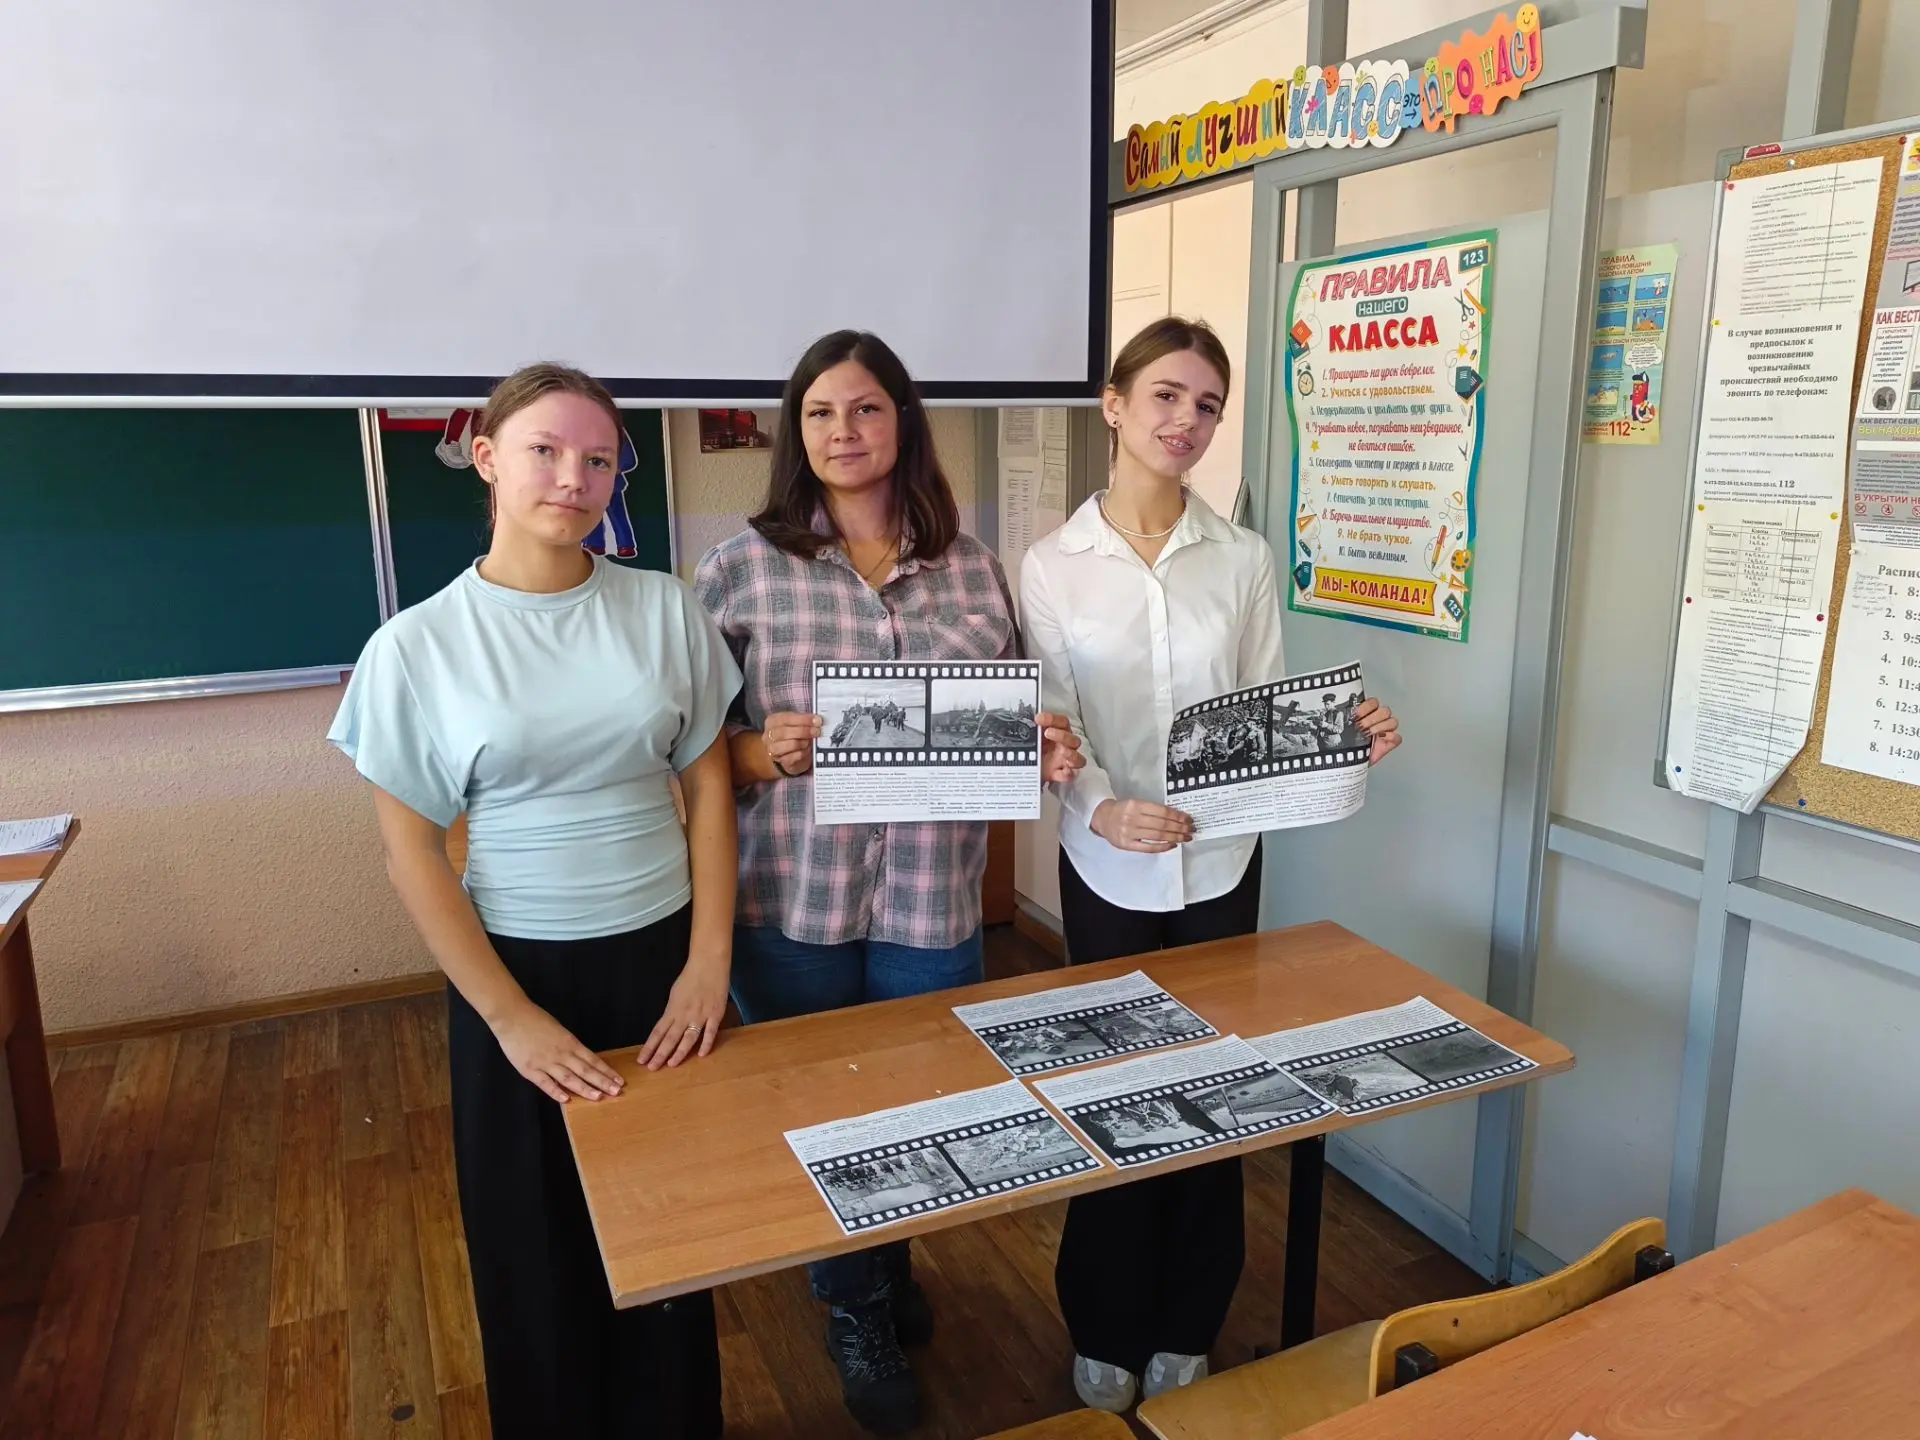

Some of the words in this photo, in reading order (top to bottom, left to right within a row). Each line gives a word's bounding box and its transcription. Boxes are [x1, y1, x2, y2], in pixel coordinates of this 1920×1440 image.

[1127, 120, 1181, 186] Самый
[1187, 84, 1286, 167] лучший
[1288, 73, 1403, 139] КЛАСС
[1424, 58, 1475, 120] ПРО
[1479, 30, 1537, 89] НАС!
[1462, 250, 1484, 266] 123
[1319, 257, 1452, 302] ПРАВИЛА
[1358, 298, 1407, 315] нашего
[1876, 312, 1894, 325] КАК
[1328, 315, 1440, 353] КЛАССА
[1735, 329, 1763, 338] случае
[1764, 324, 1833, 336] возникновения
[1749, 338, 1806, 349] предпосылок
[1747, 350, 1814, 360] возникновению
[1748, 362, 1811, 374] чрезвычайных
[1720, 376, 1782, 387] происшествий
[1783, 374, 1838, 384] необходимо
[1321, 388, 1329, 397] 2.
[1330, 387, 1361, 398] Учиться
[1775, 388, 1828, 397] телефонам:
[1609, 421, 1631, 436] 112
[1321, 476, 1329, 485] 6.
[1330, 475, 1353, 487] Уметь
[1355, 477, 1389, 489] говорить
[1398, 480, 1436, 492] слушать.
[1779, 480, 1795, 488] 112
[1863, 494, 1908, 503] УКРЫТИИ
[1337, 529, 1344, 538] 9.
[1347, 530, 1357, 539] Не
[1359, 530, 1381, 544] брать
[1384, 535, 1412, 546] чужое.
[1321, 575, 1427, 605] МЫ-КОМАНДА!
[1888, 585, 1898, 596] 1.
[1447, 599, 1461, 617] 123
[1885, 607, 1895, 618] 2.
[1905, 609, 1920, 621] 8:
[1882, 630, 1893, 641] 3.
[1880, 653, 1891, 664] 4.
[1901, 656, 1920, 668] 10:
[1878, 675, 1888, 685] 5.
[1875, 698, 1885, 708] 6.
[1895, 701, 1920, 714] 12:3
[1873, 719, 1882, 730] 7.
[1869, 741, 1879, 752] 8.
[1889, 745, 1920, 760] 14:20
